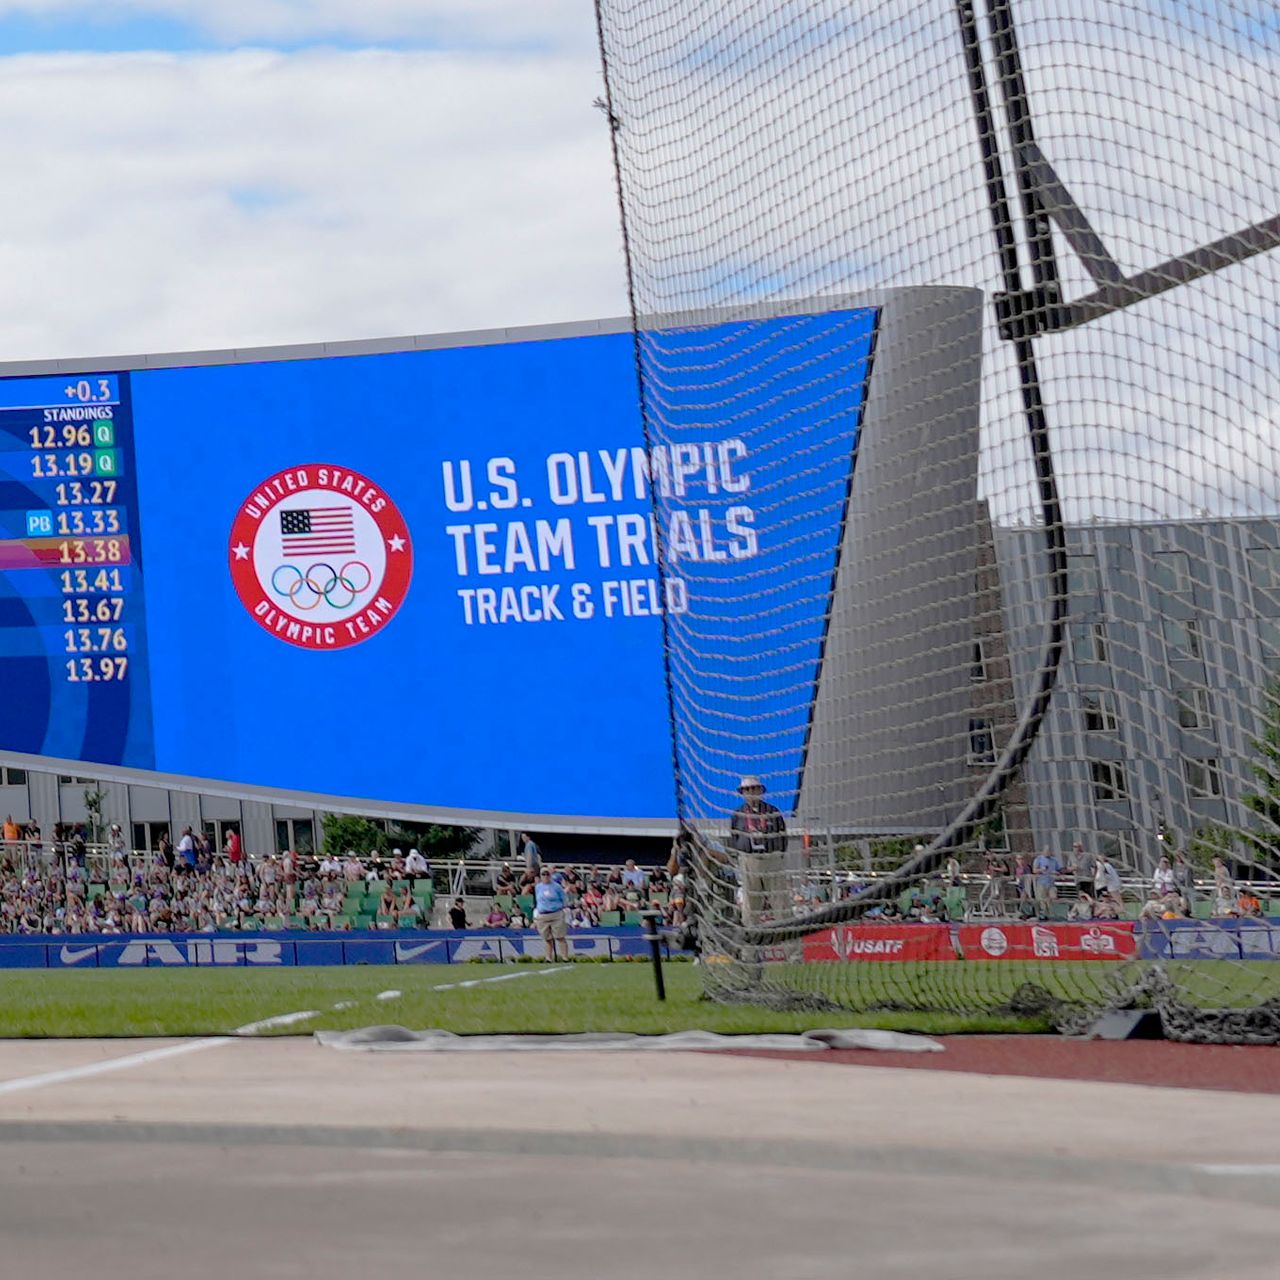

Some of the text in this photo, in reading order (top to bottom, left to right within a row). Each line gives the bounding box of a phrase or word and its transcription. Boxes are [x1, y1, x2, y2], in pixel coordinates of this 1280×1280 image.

[64, 380, 111, 402] +0.3
[43, 406, 113, 422] STANDINGS
[29, 424, 110, 449] 12.96 Q
[31, 452, 113, 477] 13.19 Q
[442, 439, 750, 512] U.S. OLYMPIC
[55, 480, 117, 505] 13.27
[245, 469, 386, 519] UNITED STATES
[29, 509, 120, 534] PB 13.33
[59, 539, 122, 563] 13.38
[446, 505, 758, 576] TEAM TRIALS
[60, 568, 123, 593] 13.41
[62, 597, 124, 622] 13.67
[457, 577, 688, 625] TRACK & FIELD
[254, 596, 393, 644] OLYMPIC TEAM
[64, 627, 128, 652] 13.76
[65, 657, 128, 682] 13.97
[117, 939, 282, 963] AIR
[853, 939, 904, 954] USATF
